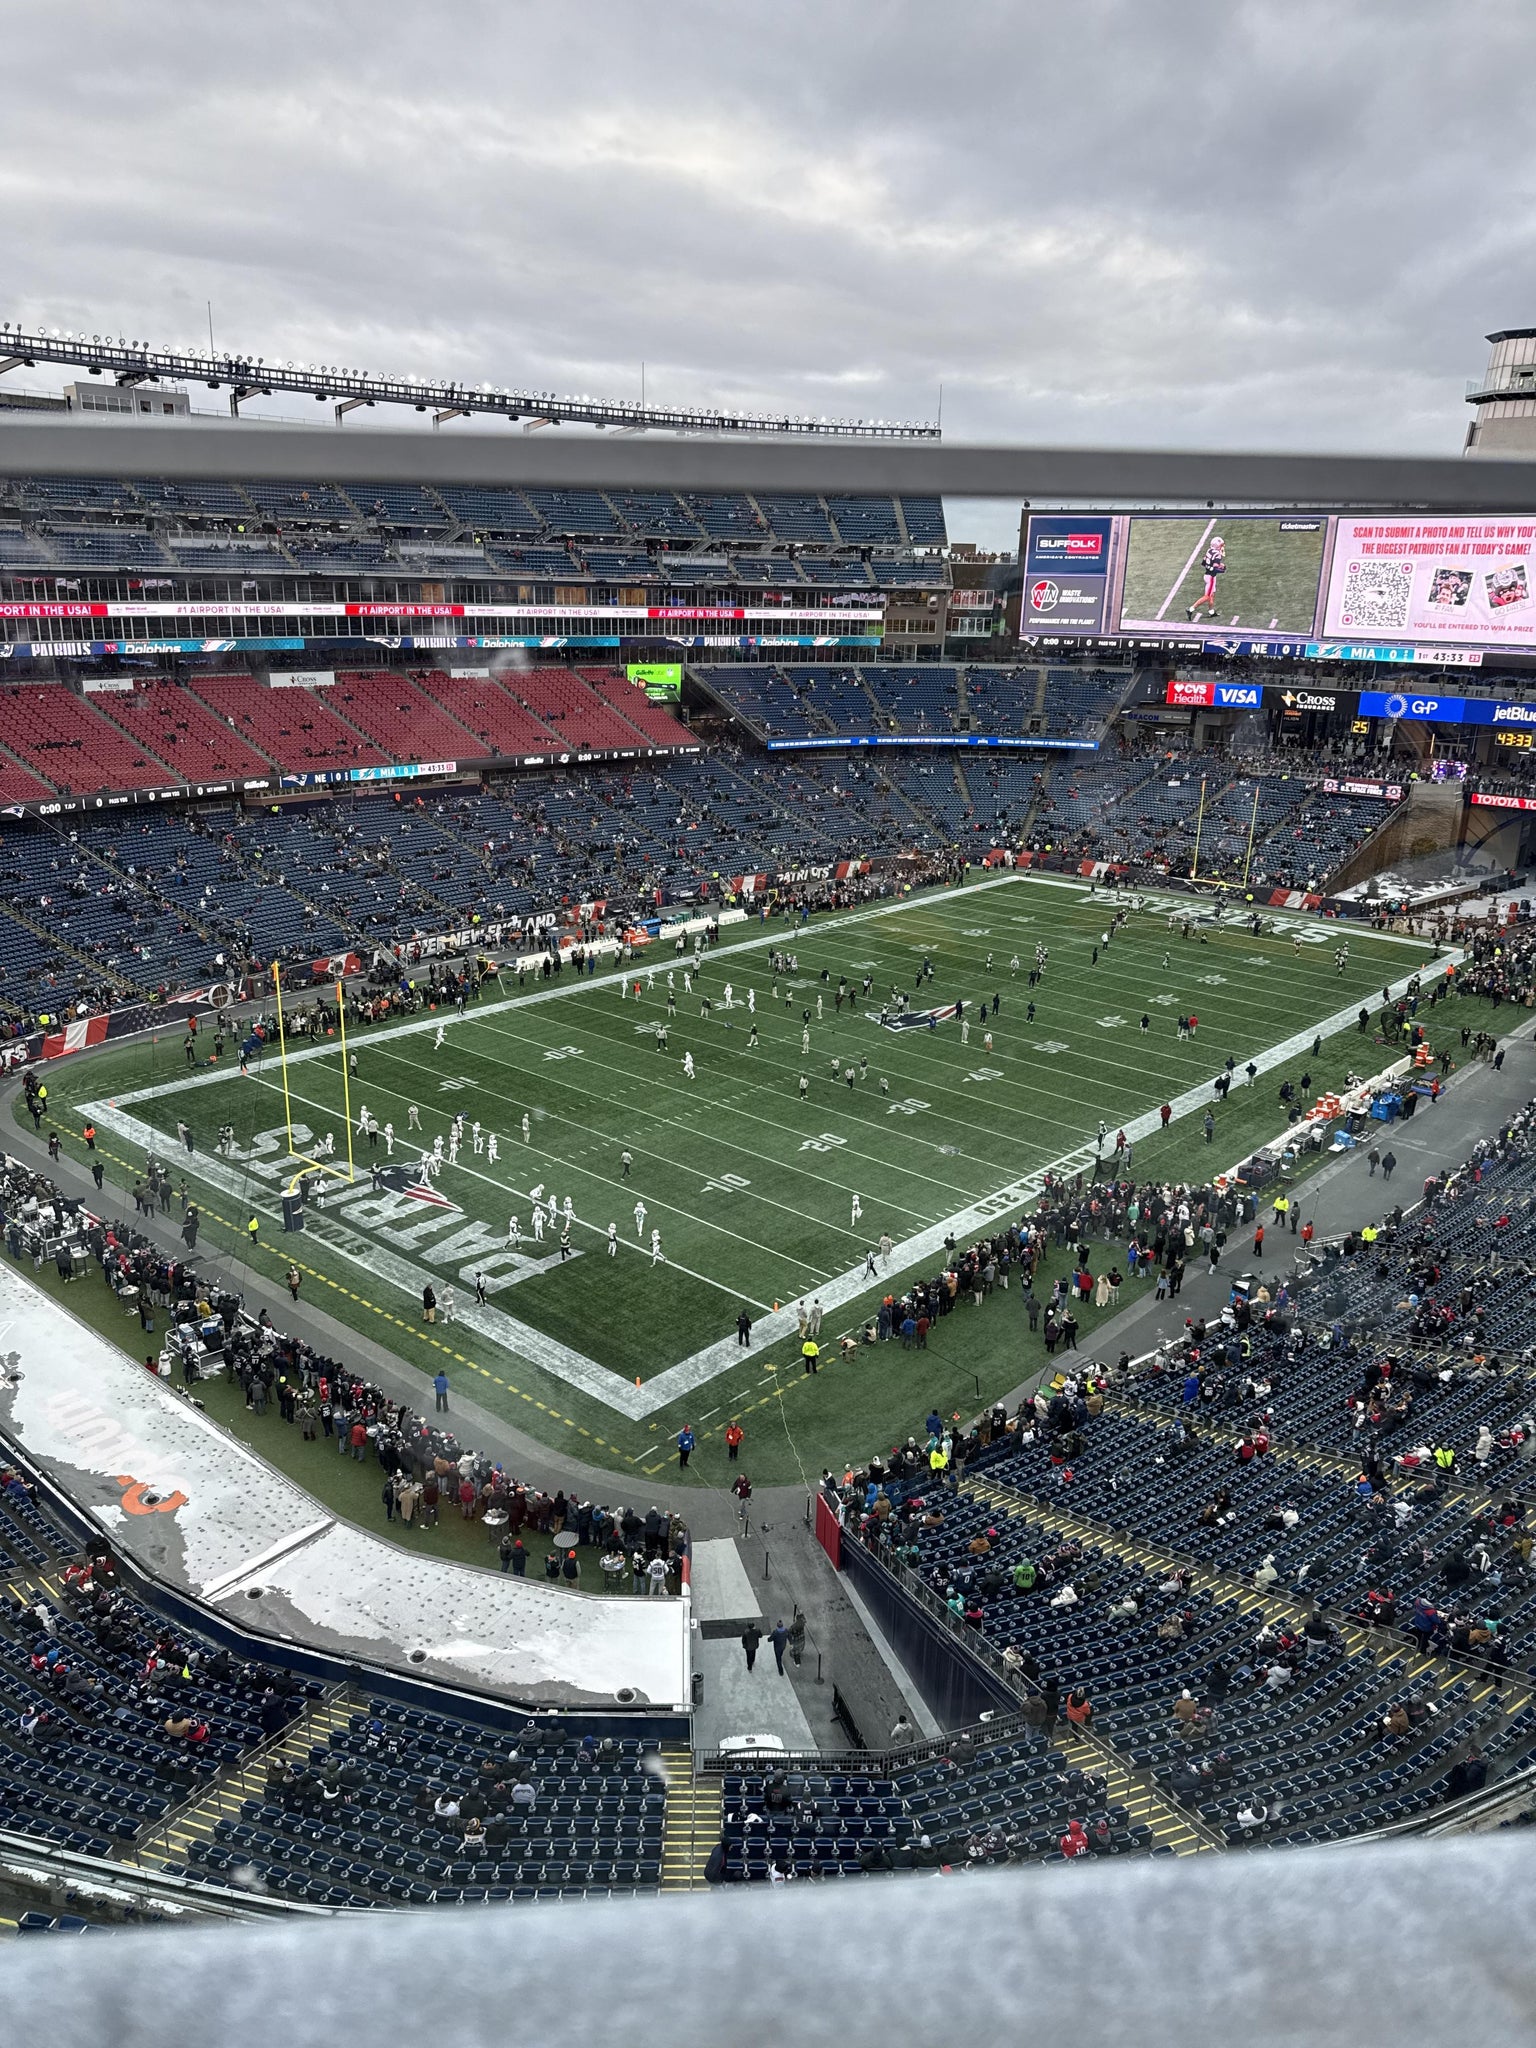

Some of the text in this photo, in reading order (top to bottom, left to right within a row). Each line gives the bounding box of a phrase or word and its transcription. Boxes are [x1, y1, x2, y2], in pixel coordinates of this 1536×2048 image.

[1353, 526, 1536, 538] SCAN TO SUBMIT A PHOTO AND TELL US WHY YOU'
[1039, 539, 1096, 548] SUFFOLK
[1362, 543, 1531, 555] THE BIGGEST PATRIOTS FAN AT TODAY'S GAME!
[1033, 589, 1057, 603] WIN
[30, 606, 40, 615] IN
[43, 606, 64, 615] THE
[68, 606, 91, 615] USA!
[358, 606, 368, 614] #1
[370, 606, 404, 614] AIRPORT
[406, 606, 415, 614] IN
[434, 607, 452, 615] USA!
[483, 640, 525, 648] Dolphins
[761, 638, 798, 646] Dolphins
[1043, 638, 1059, 646] 0:00
[1128, 640, 1134, 648] 0
[1168, 641, 1174, 649] 0
[31, 643, 90, 656] PATRIOTS
[125, 644, 181, 654] Dolphins
[1251, 644, 1290, 654] NE 0
[1351, 648, 1396, 660] MIA 0
[1433, 652, 1464, 662] 43:33
[1184, 684, 1207, 694] CVS
[1219, 688, 1258, 704] VISA
[1296, 692, 1336, 706] CROSS
[1492, 706, 1536, 722] jetBlue
[1353, 722, 1368, 732] 25
[1497, 733, 1533, 747] 43:33
[578, 753, 591, 761] 0:00
[380, 766, 409, 777] MIA 0
[315, 772, 341, 783] NE 0
[198, 786, 203, 795] 0
[149, 792, 155, 801] 0
[1477, 794, 1520, 808] TOYOTA
[40, 803, 61, 814] 0:00
[96, 798, 102, 808] 0
[451, 928, 485, 947] NEW
[545, 1046, 584, 1060] 20
[967, 1066, 1004, 1081] 40
[440, 1076, 479, 1090] 10
[889, 1098, 932, 1115] 30
[800, 1132, 848, 1153] 20
[704, 1172, 751, 1194] 10
[973, 1192, 1020, 1216] 250
[306, 1222, 375, 1256] STOP
[652, 1567, 662, 1575] 50
[803, 1815, 813, 1824] 10
